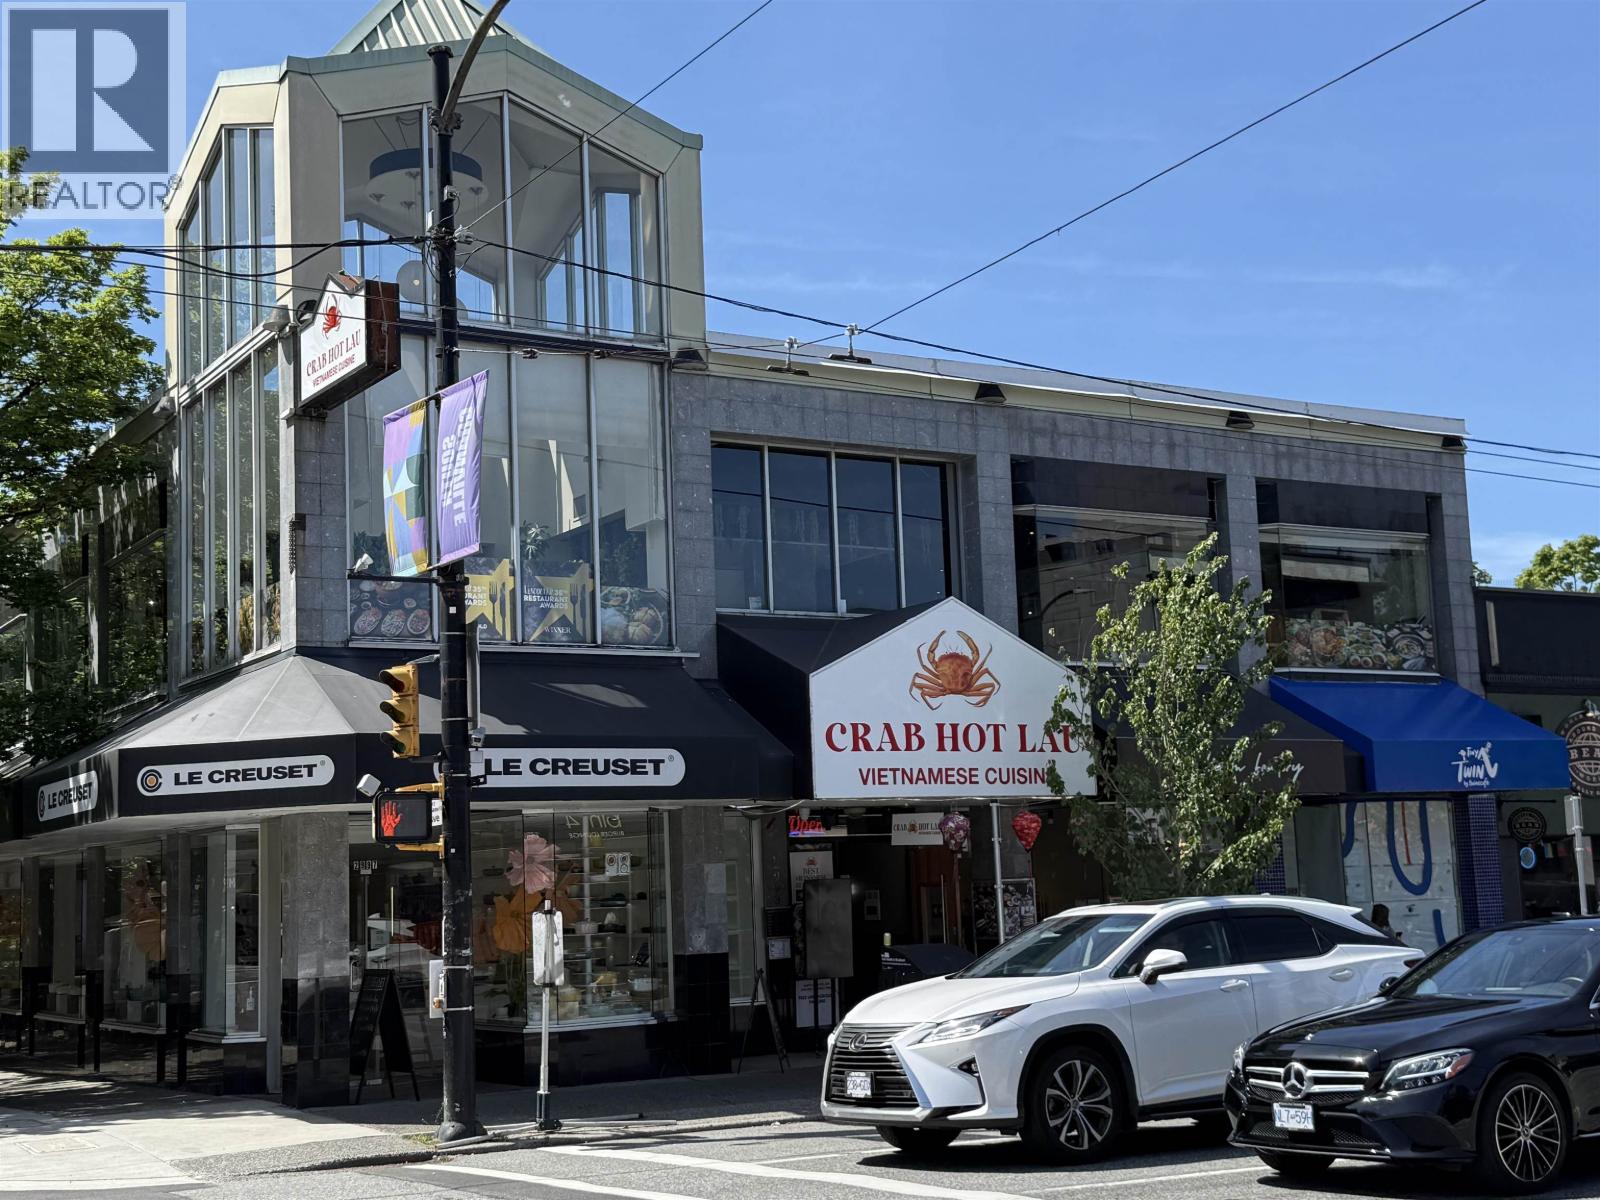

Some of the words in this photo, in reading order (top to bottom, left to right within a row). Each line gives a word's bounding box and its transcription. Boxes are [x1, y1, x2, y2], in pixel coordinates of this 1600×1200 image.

[306, 352, 327, 377] CRAB
[328, 340, 345, 365] HOT
[346, 329, 361, 354] LAU
[312, 364, 338, 388] VIETNAMESE
[523, 594, 569, 603] RESTAURANT
[540, 601, 569, 609] AWARDS
[824, 721, 926, 753] CRAB
[935, 722, 1007, 753] HOT
[1017, 723, 1084, 754] LAU
[174, 771, 203, 787] LE
[207, 763, 318, 784] CREUSET
[484, 758, 523, 776] LE
[528, 757, 666, 776] CREUSET
[858, 766, 980, 786] VIETNAMESE
[985, 766, 1052, 786] CUISIN
[47, 791, 58, 810] LE
[58, 780, 94, 807] CREUSET
